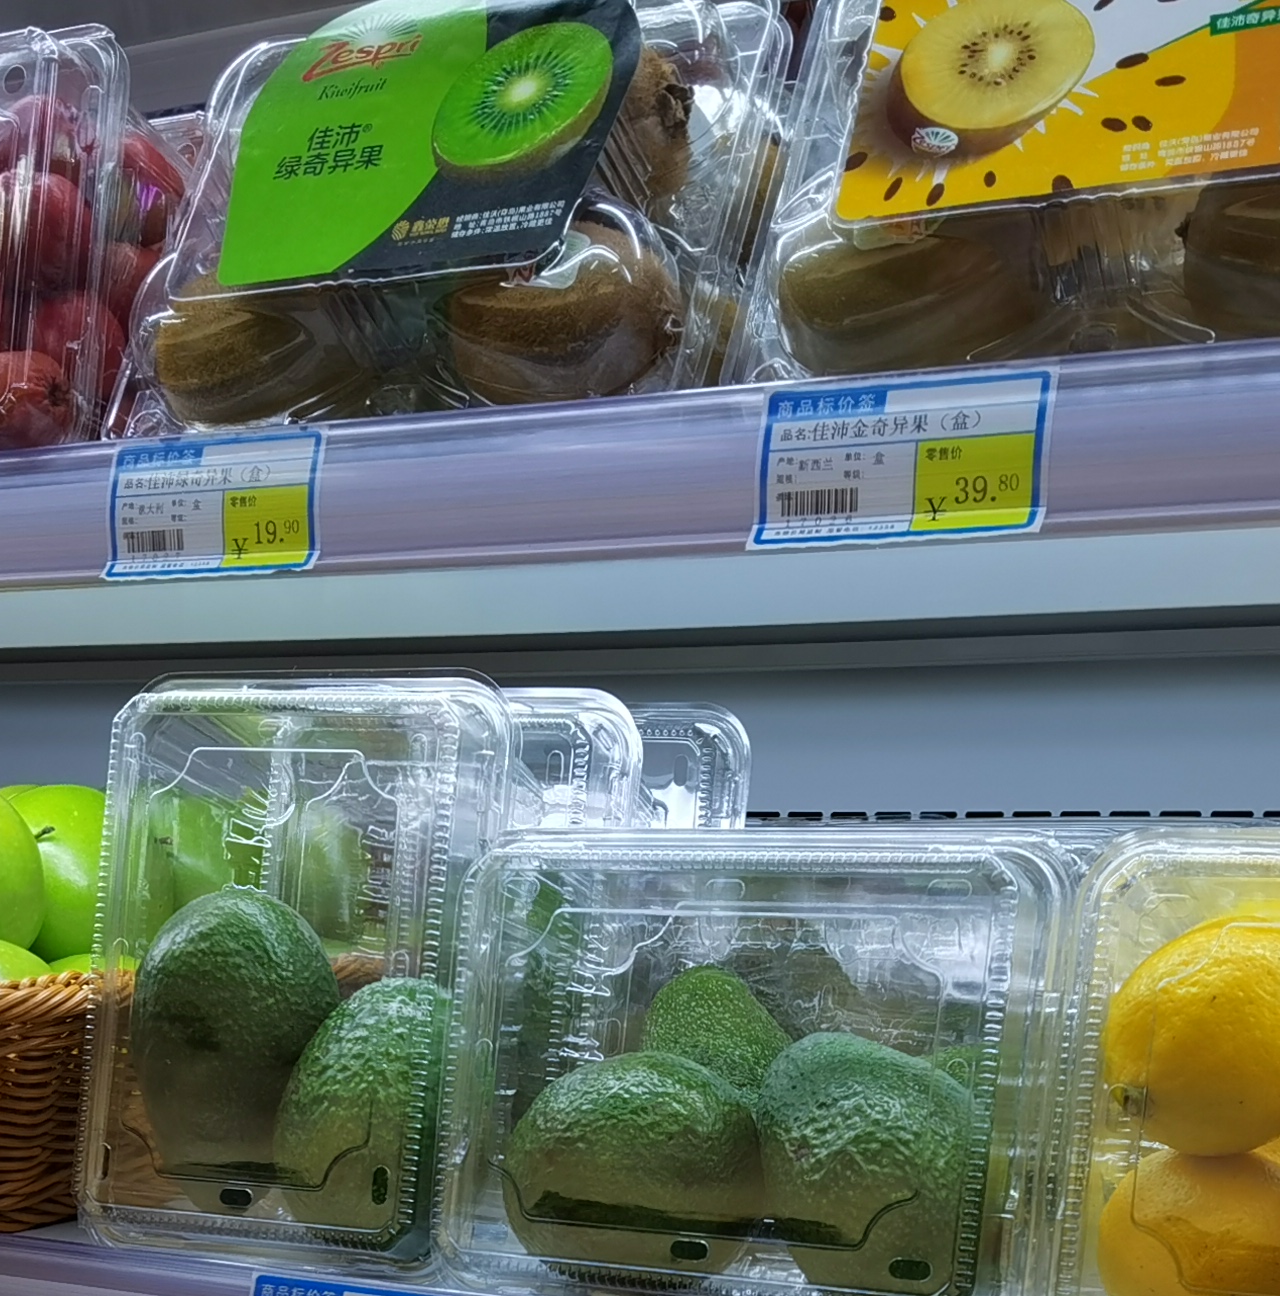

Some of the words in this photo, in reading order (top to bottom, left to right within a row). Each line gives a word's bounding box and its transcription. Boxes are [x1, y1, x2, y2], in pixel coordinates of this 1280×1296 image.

[301, 33, 423, 83] Zespri
[318, 78, 387, 101] Kiwifruit
[272, 145, 384, 181] 绿奇异果
[777, 394, 876, 418] 商品标价签
[123, 450, 195, 468] 商品标价签
[798, 457, 834, 472] 新西兰
[925, 446, 962, 461] 零售价
[954, 473, 1020, 505] 39.80
[230, 495, 257, 508] 零售价
[254, 520, 300, 545] 19.90
